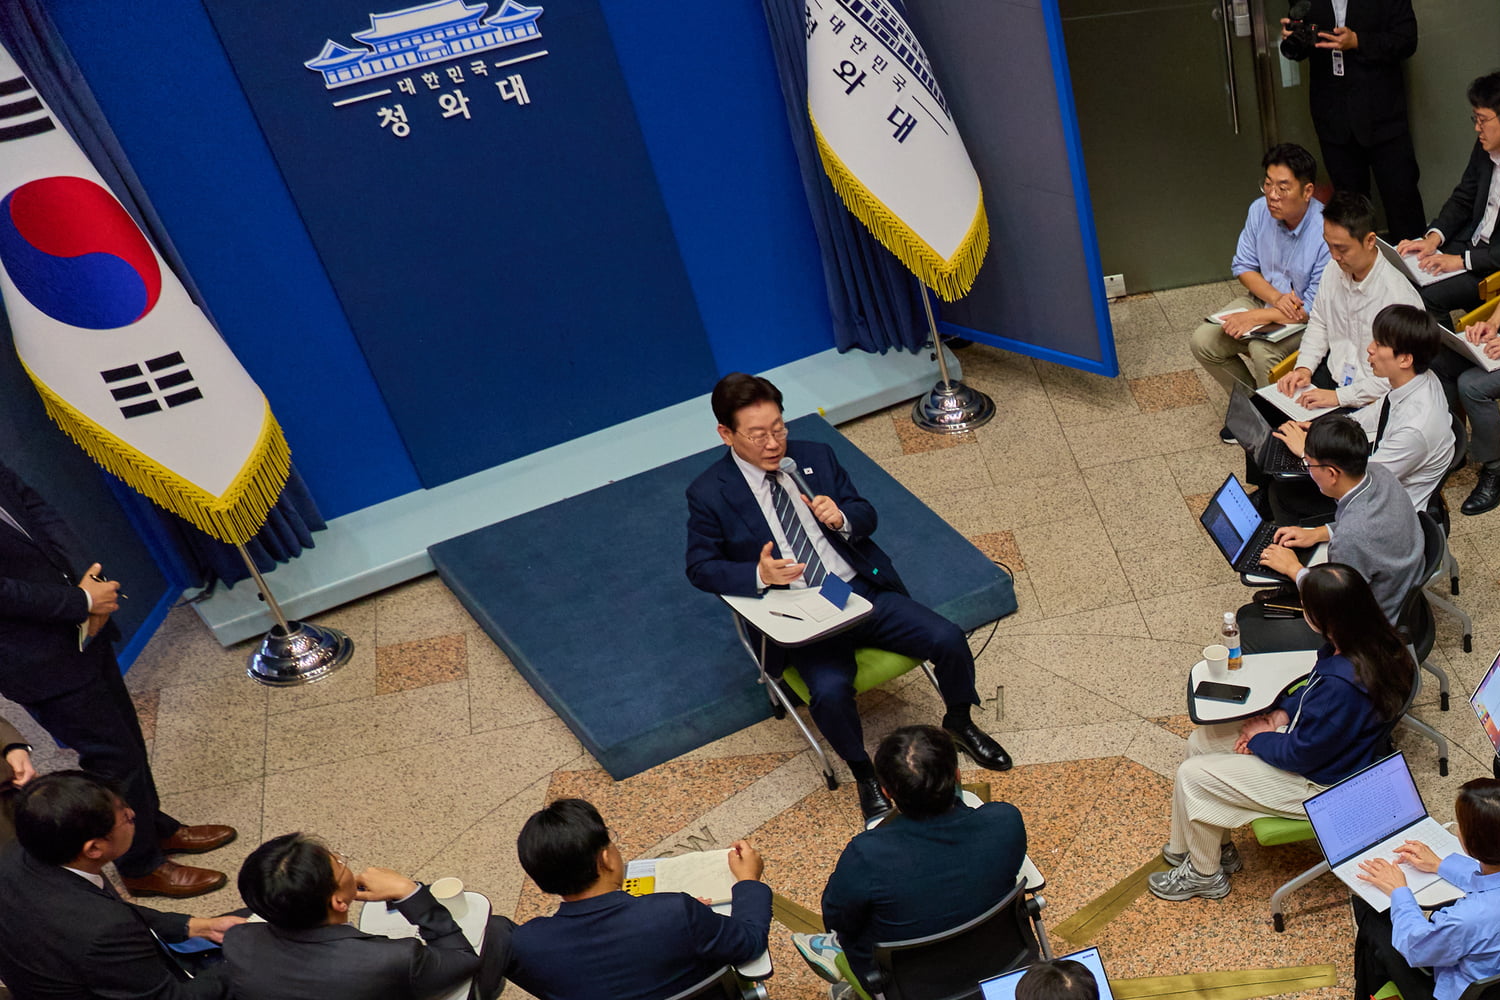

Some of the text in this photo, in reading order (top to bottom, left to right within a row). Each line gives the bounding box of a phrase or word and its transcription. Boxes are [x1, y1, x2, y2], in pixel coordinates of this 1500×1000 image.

[396, 60, 489, 96] 대한민국
[829, 14, 907, 93] 대한민국
[376, 73, 531, 138] 청와대
